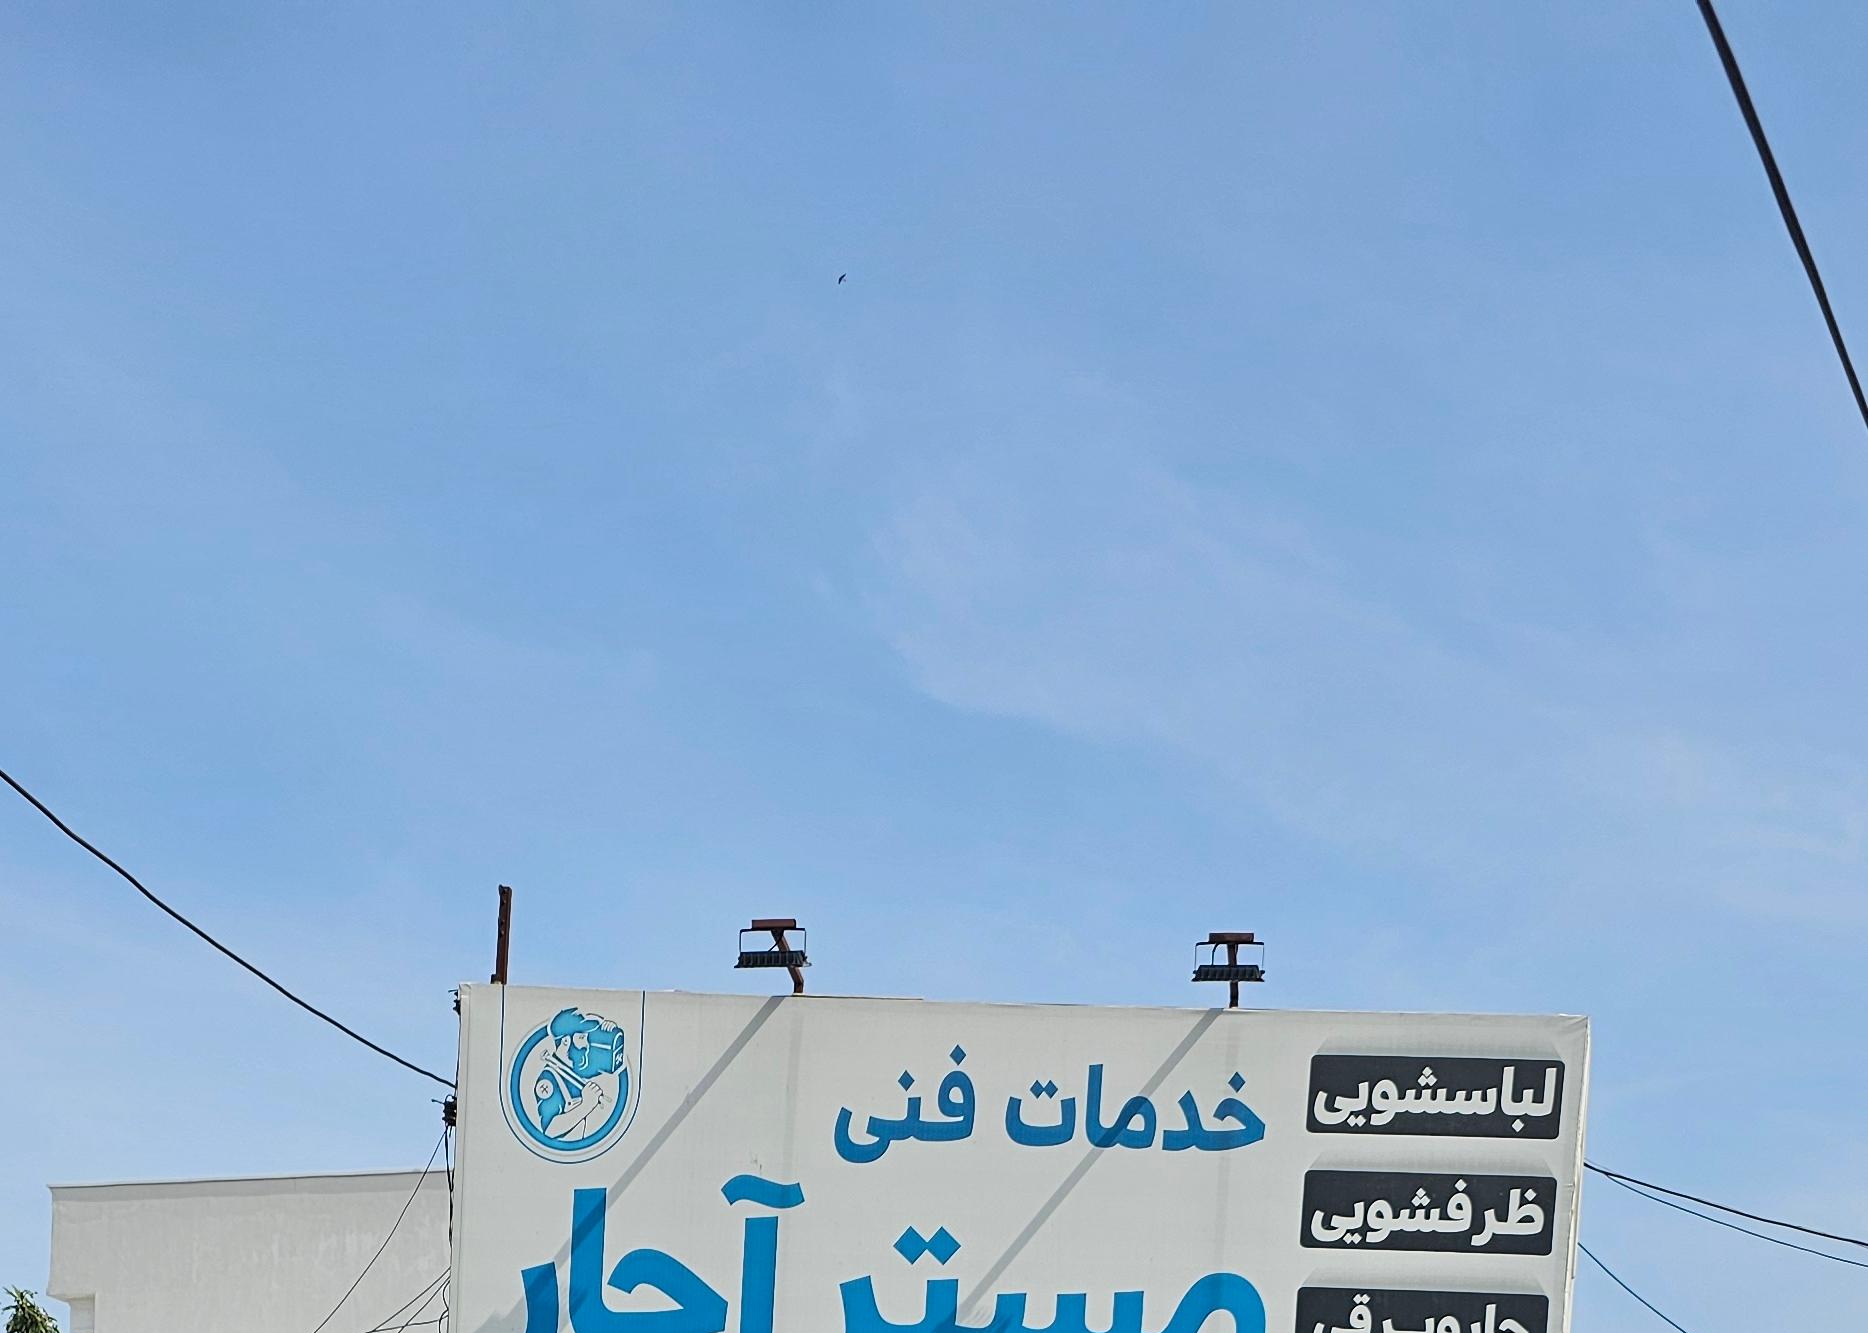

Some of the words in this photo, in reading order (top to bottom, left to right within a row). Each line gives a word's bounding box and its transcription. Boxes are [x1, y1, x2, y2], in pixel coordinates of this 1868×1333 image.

[834, 1045, 976, 1163] فنی
[1005, 1064, 1265, 1152] خدمات
[1312, 1066, 1557, 1132] لباسشویی
[1310, 1179, 1545, 1247] ظرفشویی
